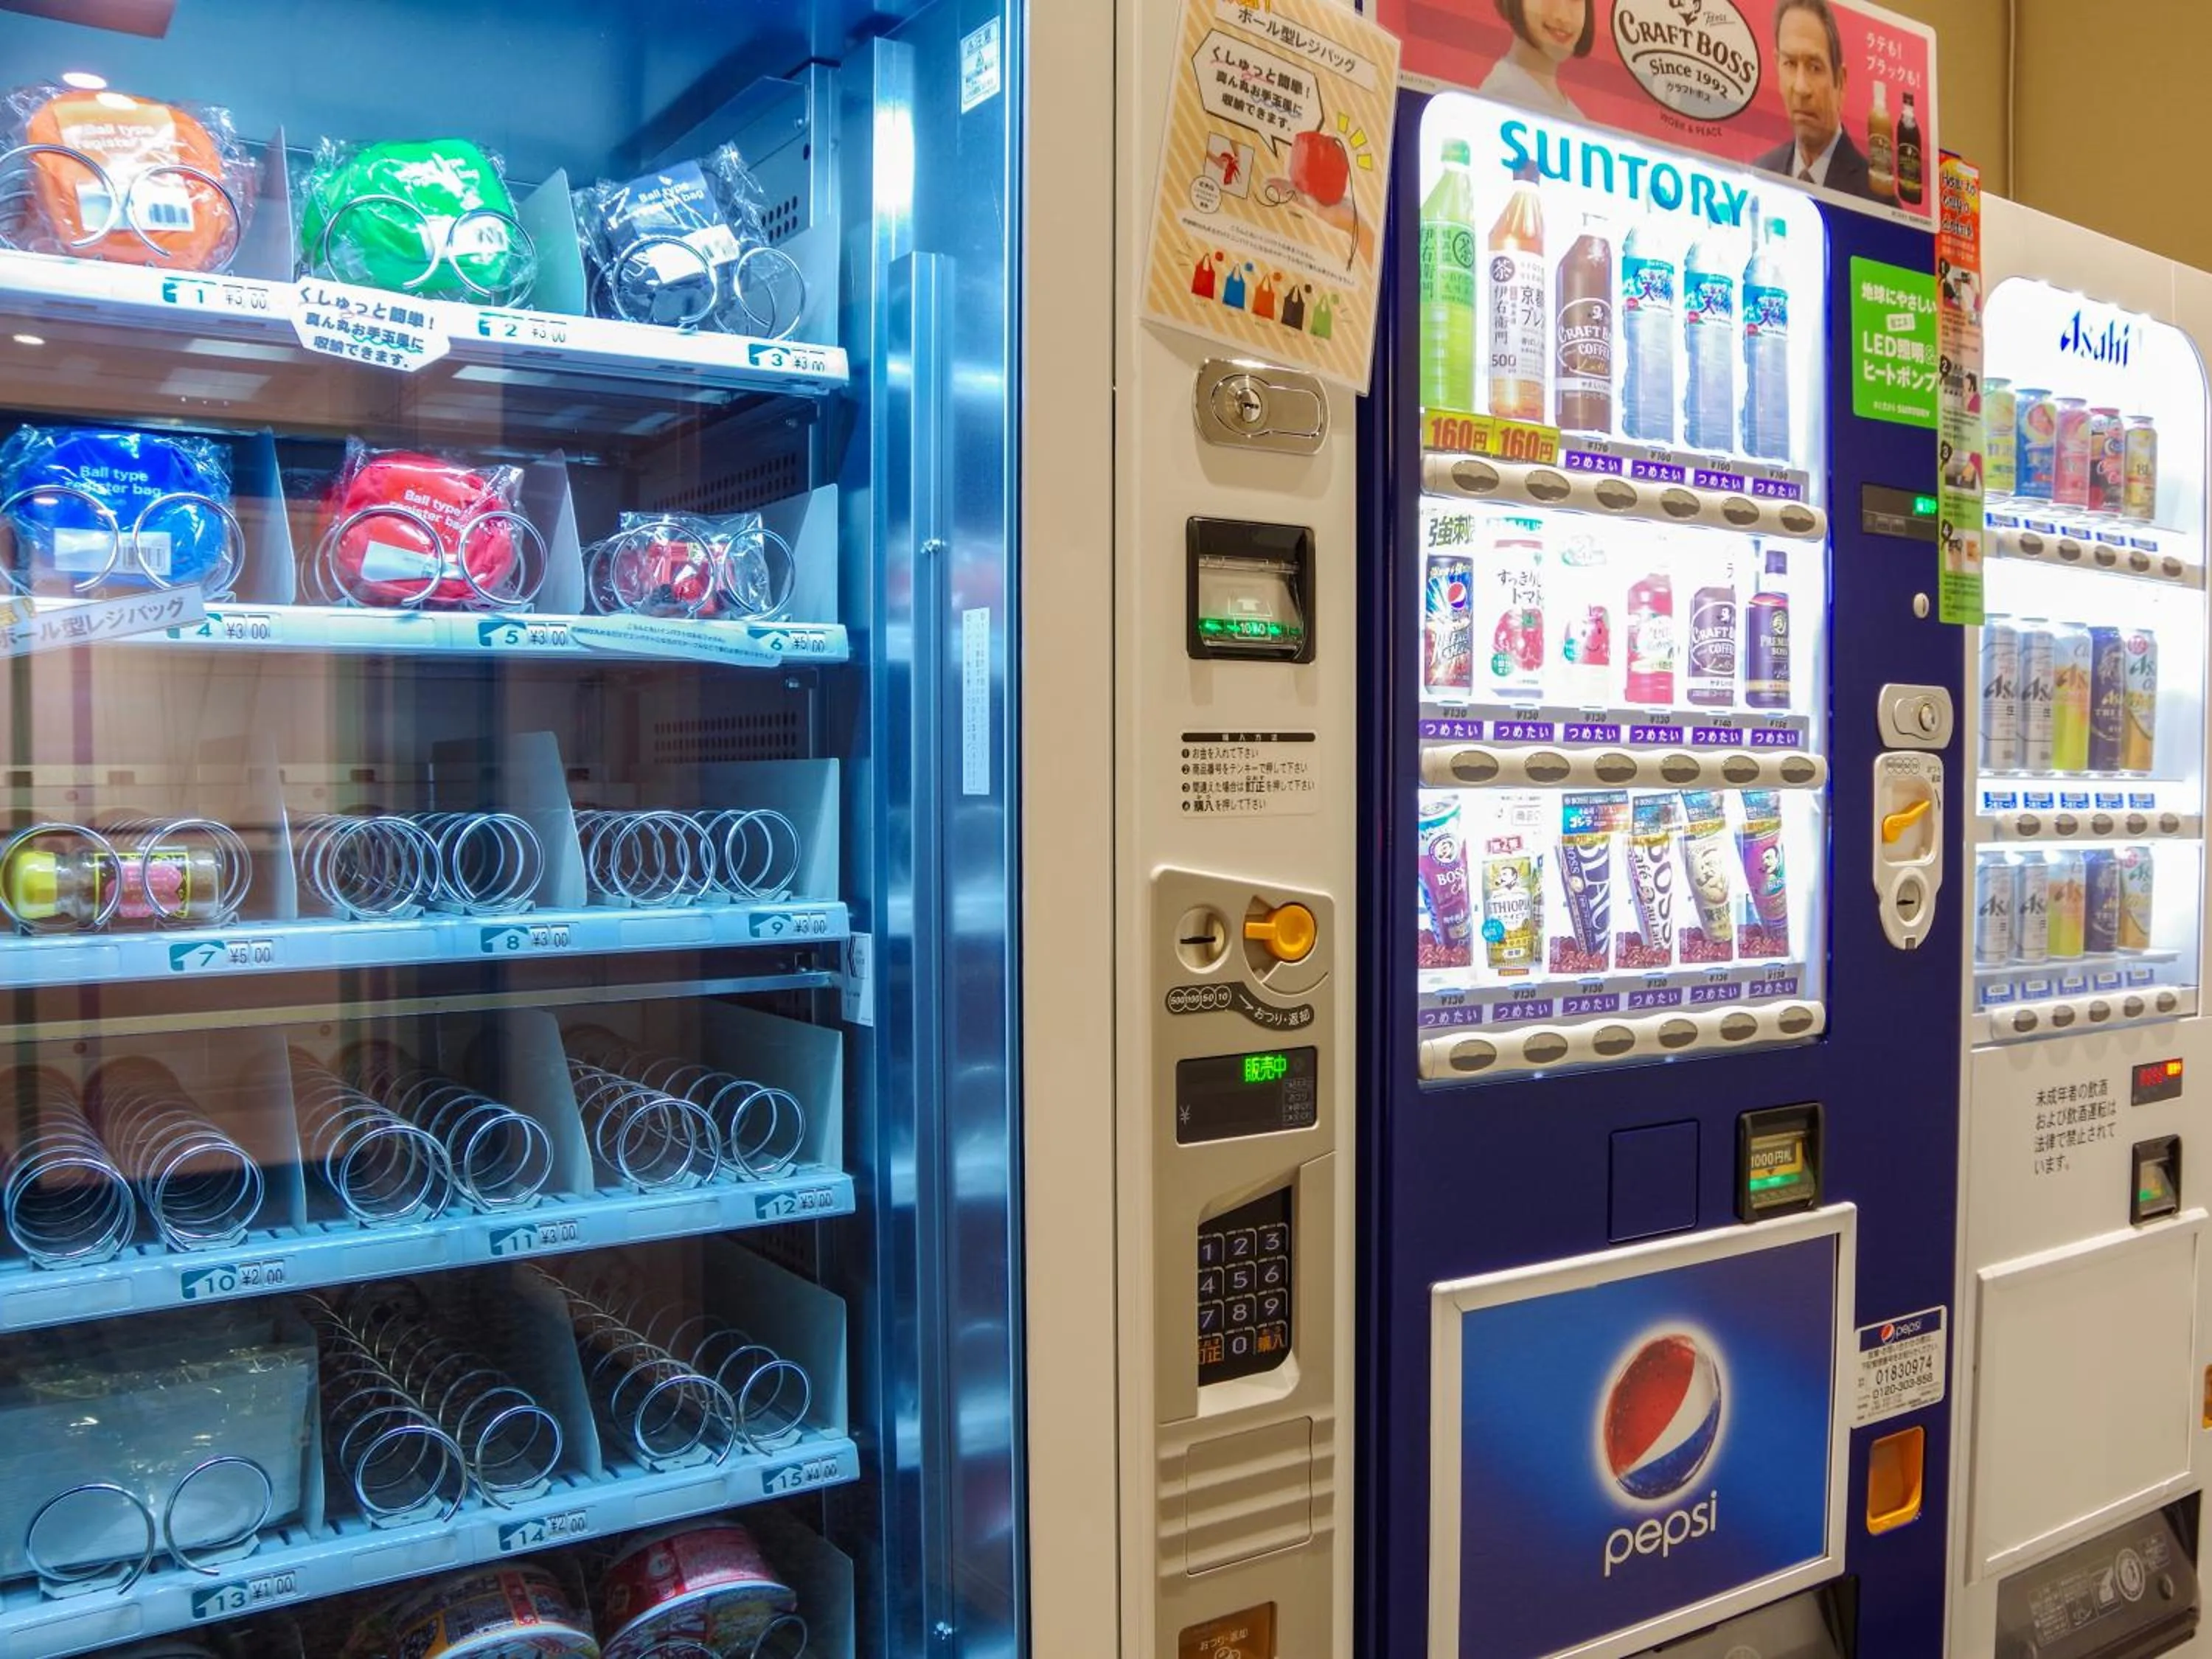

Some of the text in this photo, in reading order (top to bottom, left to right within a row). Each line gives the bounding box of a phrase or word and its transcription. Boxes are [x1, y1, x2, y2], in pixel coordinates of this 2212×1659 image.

[1239, 8, 1355, 72] ボール型レジバッグ
[1618, 10, 1756, 83] CRAFT BOSS
[1649, 59, 1728, 99] Since 1992
[1666, 82, 1711, 103] クラフトボス
[1697, 126, 1722, 137] PEACE
[1499, 119, 1750, 229] SUNTORY
[638, 189, 661, 203] Ball
[681, 189, 704, 201] bag
[1492, 258, 1513, 279] 茶
[198, 289, 204, 304] 1
[1862, 281, 1937, 313] 地球にやさしい
[505, 323, 517, 337] 2
[1558, 326, 1602, 343] CRAFT
[2059, 308, 2129, 368] Asahi
[771, 354, 783, 366] 3
[1492, 353, 1517, 367] 500
[1431, 417, 1554, 462] 160円 160円
[1571, 455, 1618, 471] つめたい
[1636, 464, 1680, 480] つめたい
[80, 465, 148, 483] Ball type
[1698, 474, 1741, 490] つめたい
[133, 484, 161, 498] bag
[1757, 481, 1797, 498] つめたい
[404, 489, 461, 517] Ball type
[195, 622, 271, 640] 4 ¥300
[504, 630, 518, 644] 5
[530, 630, 566, 646] ¥300
[1691, 626, 1729, 644] CRAFT
[771, 638, 782, 651] 6
[1425, 723, 1478, 737] つめたい
[1499, 725, 1549, 738] つめたい
[1569, 727, 1615, 739] つめたい
[1634, 730, 1680, 741] つめたい
[1696, 731, 1739, 743] つめたい
[1756, 732, 1795, 745] つめたい
[772, 918, 826, 934] 9 ¥300
[507, 931, 568, 950] 8 ¥300
[200, 947, 271, 967] 7 ¥500
[1202, 993, 1214, 1002] 50
[1218, 992, 1228, 1001] 10
[1696, 987, 1738, 1002] つめたい
[1753, 981, 1795, 995] つめたい
[1568, 999, 1615, 1012] つめたい
[1634, 992, 1679, 1007] つめたい
[1425, 1011, 1478, 1024] つめたい
[1499, 1005, 1548, 1019] つめたい
[1245, 1054, 1287, 1082] 販売中
[2036, 1079, 2108, 1107] 未成年者の飲酒
[1180, 1105, 1190, 1124] ¥
[2036, 1100, 2117, 1131] および飲酒運転は
[2035, 1122, 2117, 1152] 法律で禁止されて
[773, 1192, 831, 1215] 12 ¥300
[510, 1225, 577, 1251] 11 ¥300
[1204, 1233, 1280, 1261] 1 2 3
[205, 1267, 283, 1293] 10 ¥200
[1200, 1265, 1279, 1294] 4 5 6
[1200, 1298, 1279, 1327] 7 8 9
[1232, 1336, 1247, 1354] 0
[1876, 1354, 1933, 1385] 01830974
[779, 1470, 801, 1489] 15
[519, 1516, 585, 1545] 14 ¥200
[1604, 1489, 1718, 1577] pepsi
[215, 1576, 293, 1610] 13 ¥100
